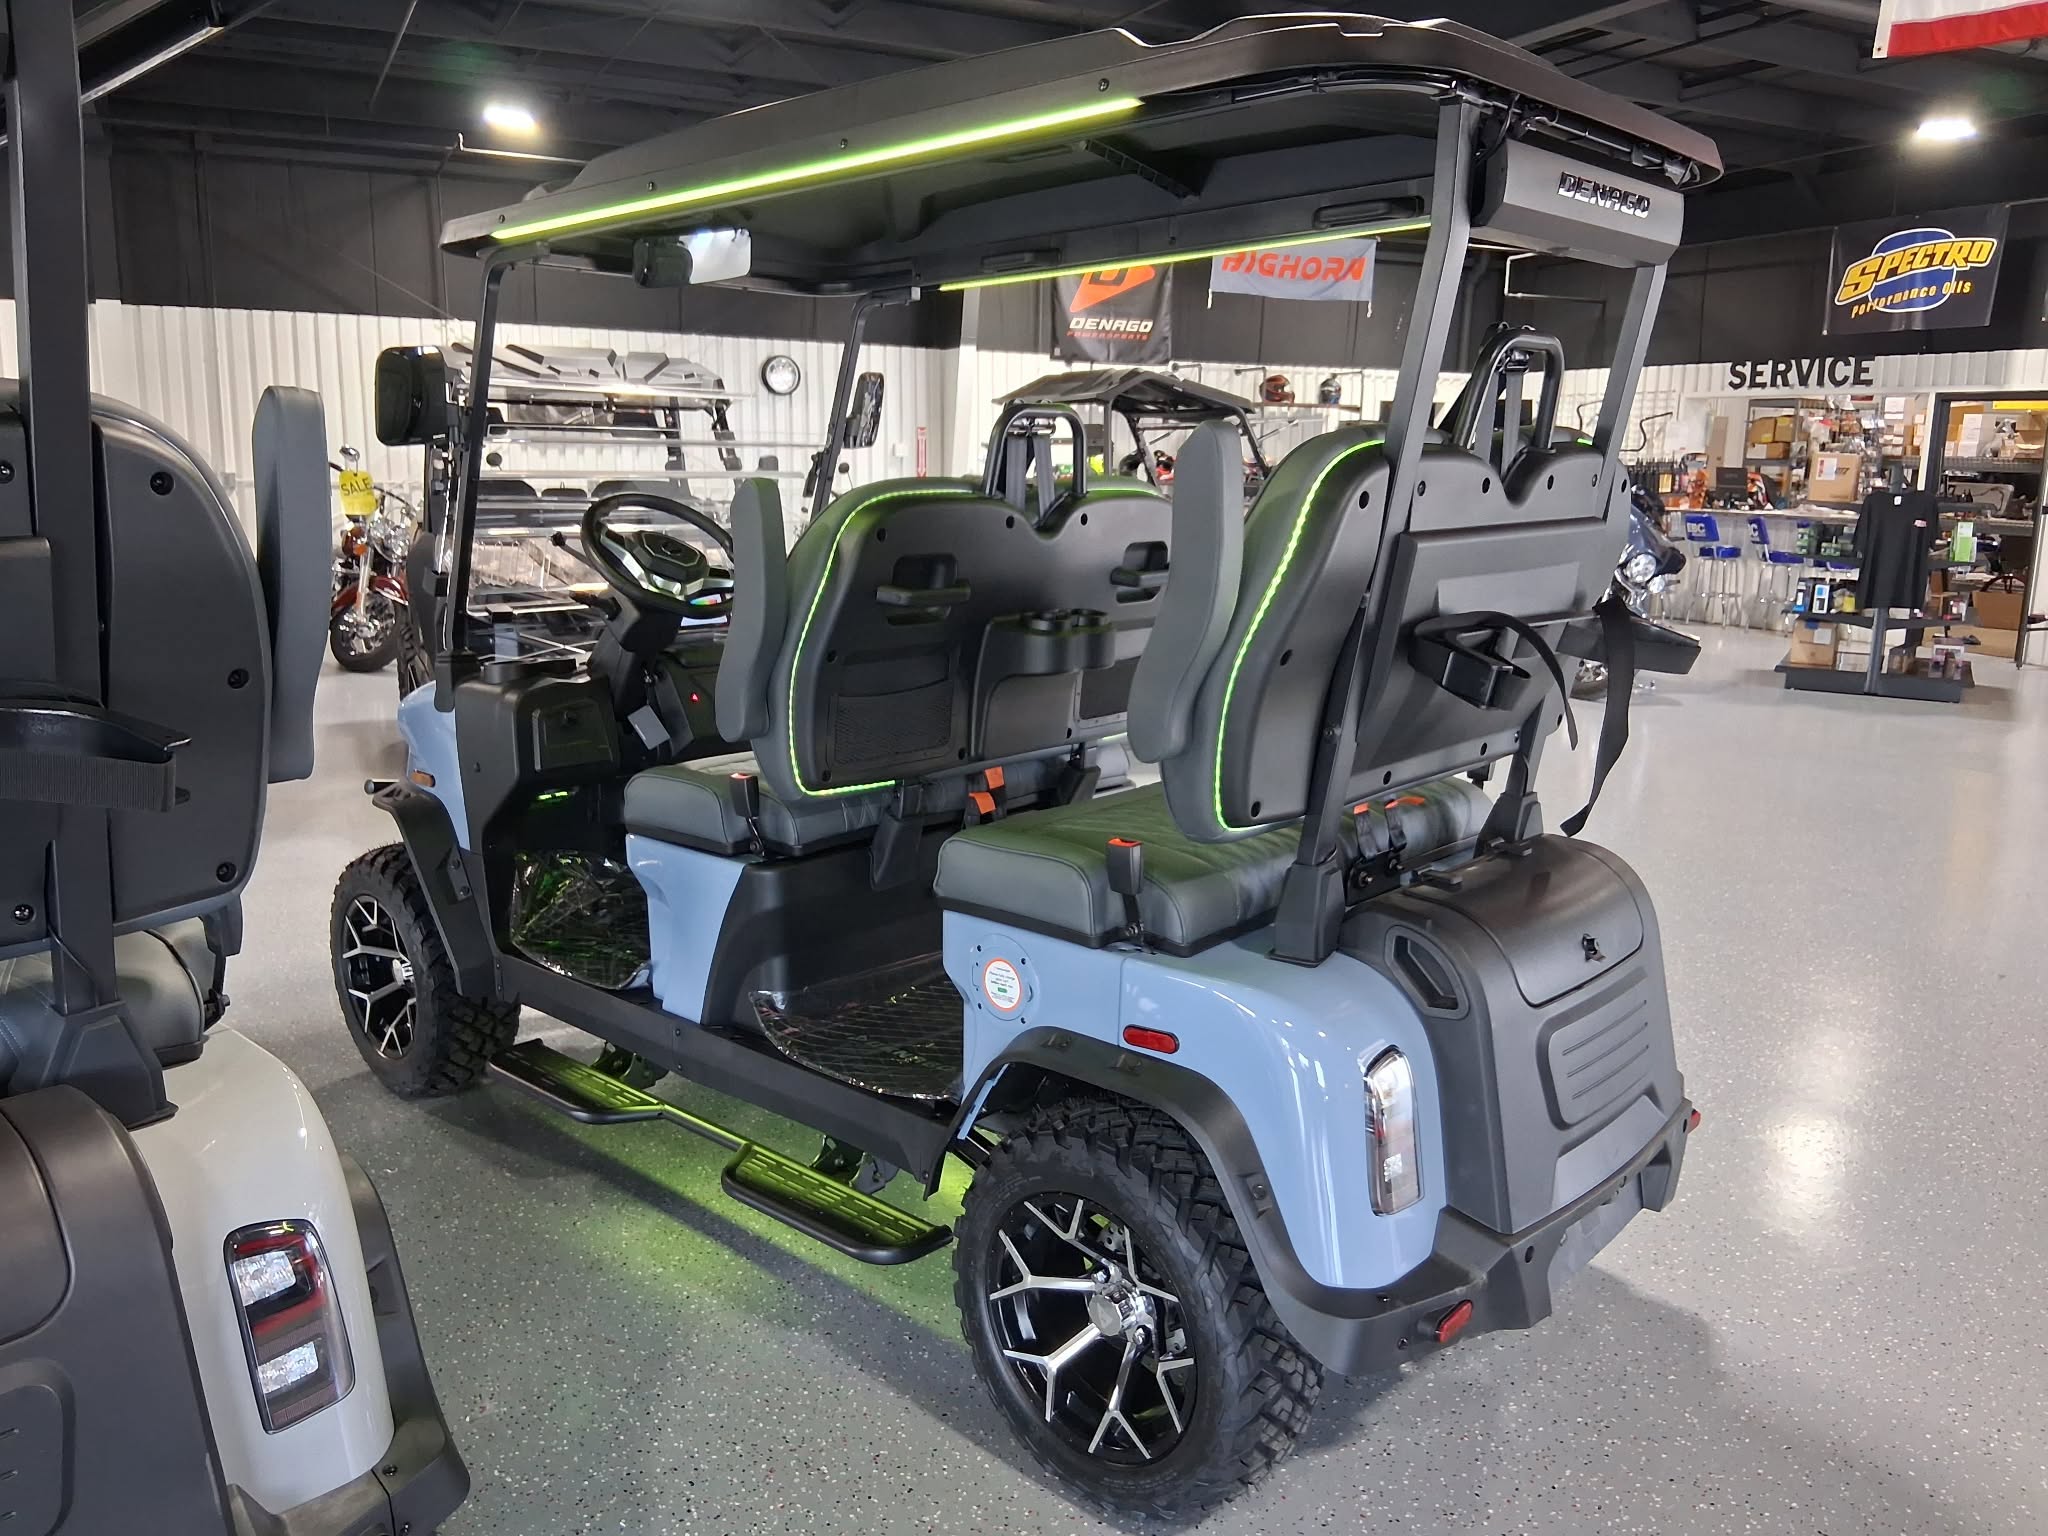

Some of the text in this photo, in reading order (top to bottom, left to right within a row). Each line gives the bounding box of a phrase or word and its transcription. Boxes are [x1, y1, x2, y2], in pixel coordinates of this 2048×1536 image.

[1557, 171, 1651, 219] DENAGO
[1221, 250, 1368, 283] BIGHORN
[1836, 239, 1997, 304] SPECTRO
[1069, 317, 1154, 333] DENAGO
[1728, 356, 1875, 390] SERVICE
[341, 477, 371, 497] SALE
